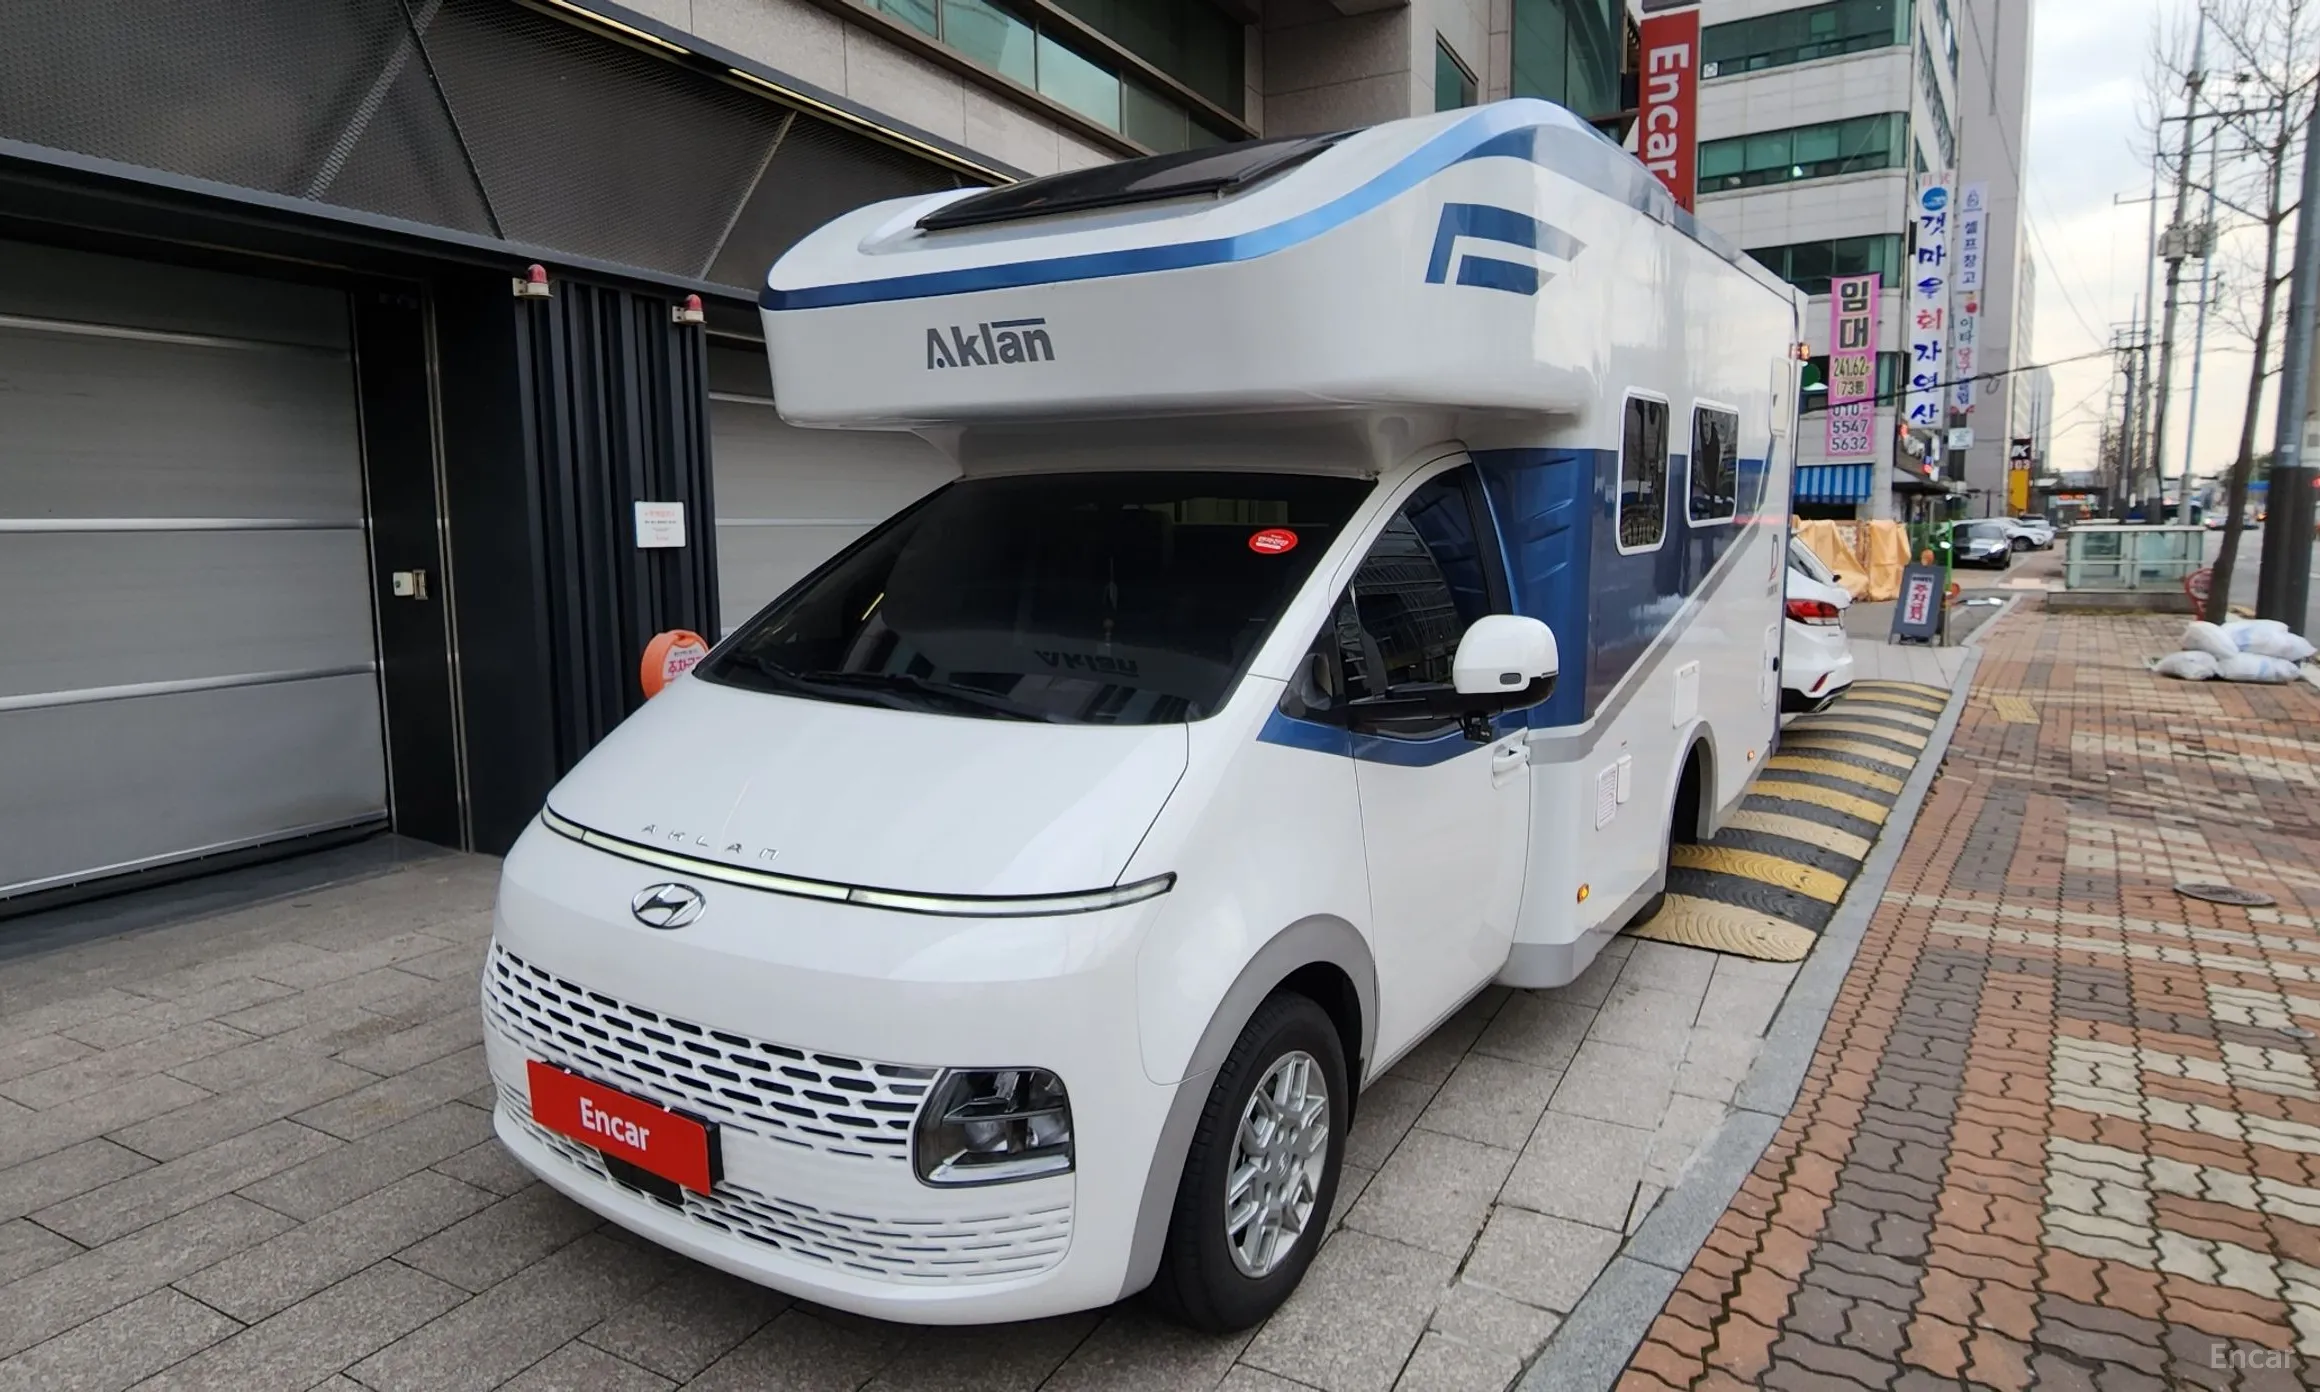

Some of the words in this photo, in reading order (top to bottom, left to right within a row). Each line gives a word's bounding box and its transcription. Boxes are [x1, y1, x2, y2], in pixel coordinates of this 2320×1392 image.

[1647, 43, 1690, 179] Encar
[1839, 280, 1869, 350] 임대
[926, 318, 1055, 370] Aklan
[1831, 437, 1868, 451] 5632
[1832, 419, 1868, 434] 5547
[579, 1096, 650, 1152] Encar
